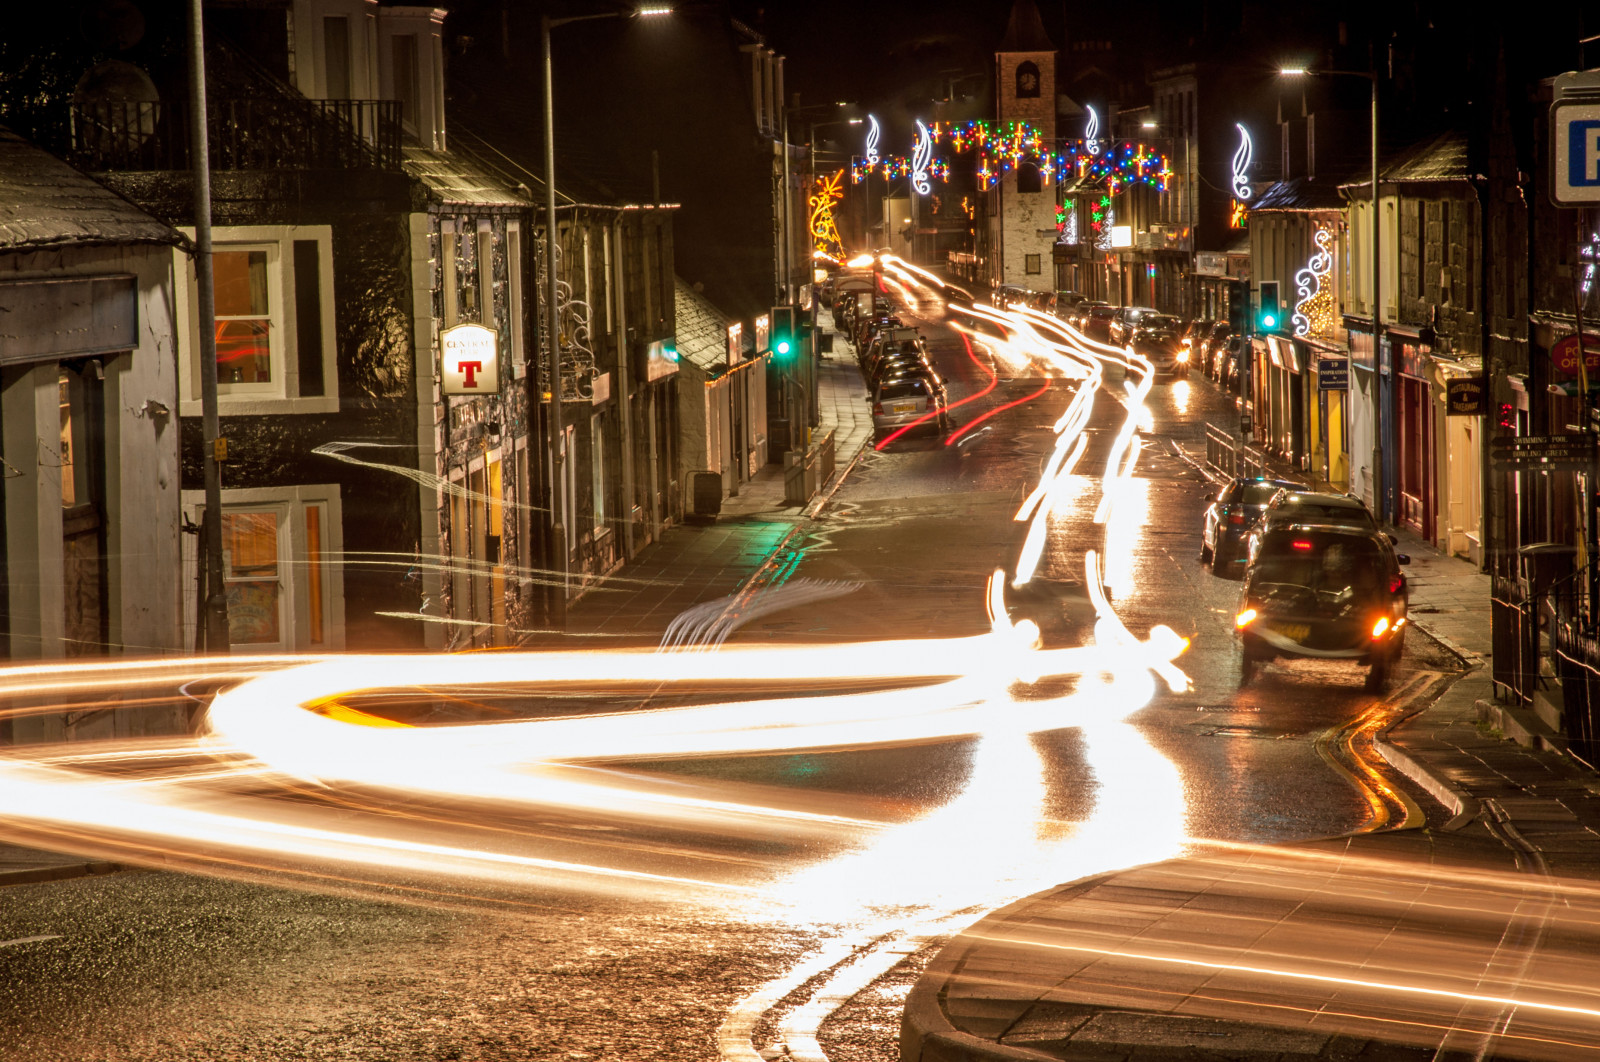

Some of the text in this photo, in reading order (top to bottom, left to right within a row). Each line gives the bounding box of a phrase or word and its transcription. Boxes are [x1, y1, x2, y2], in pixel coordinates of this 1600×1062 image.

[1561, 356, 1599, 368] OFCE
[458, 361, 482, 388] T
[1450, 383, 1481, 394] RESTAURANT
[1452, 401, 1479, 412] TAKEAWAY
[1513, 437, 1547, 445] SWIMMING
[1512, 449, 1569, 458] BOWLING GREEN
